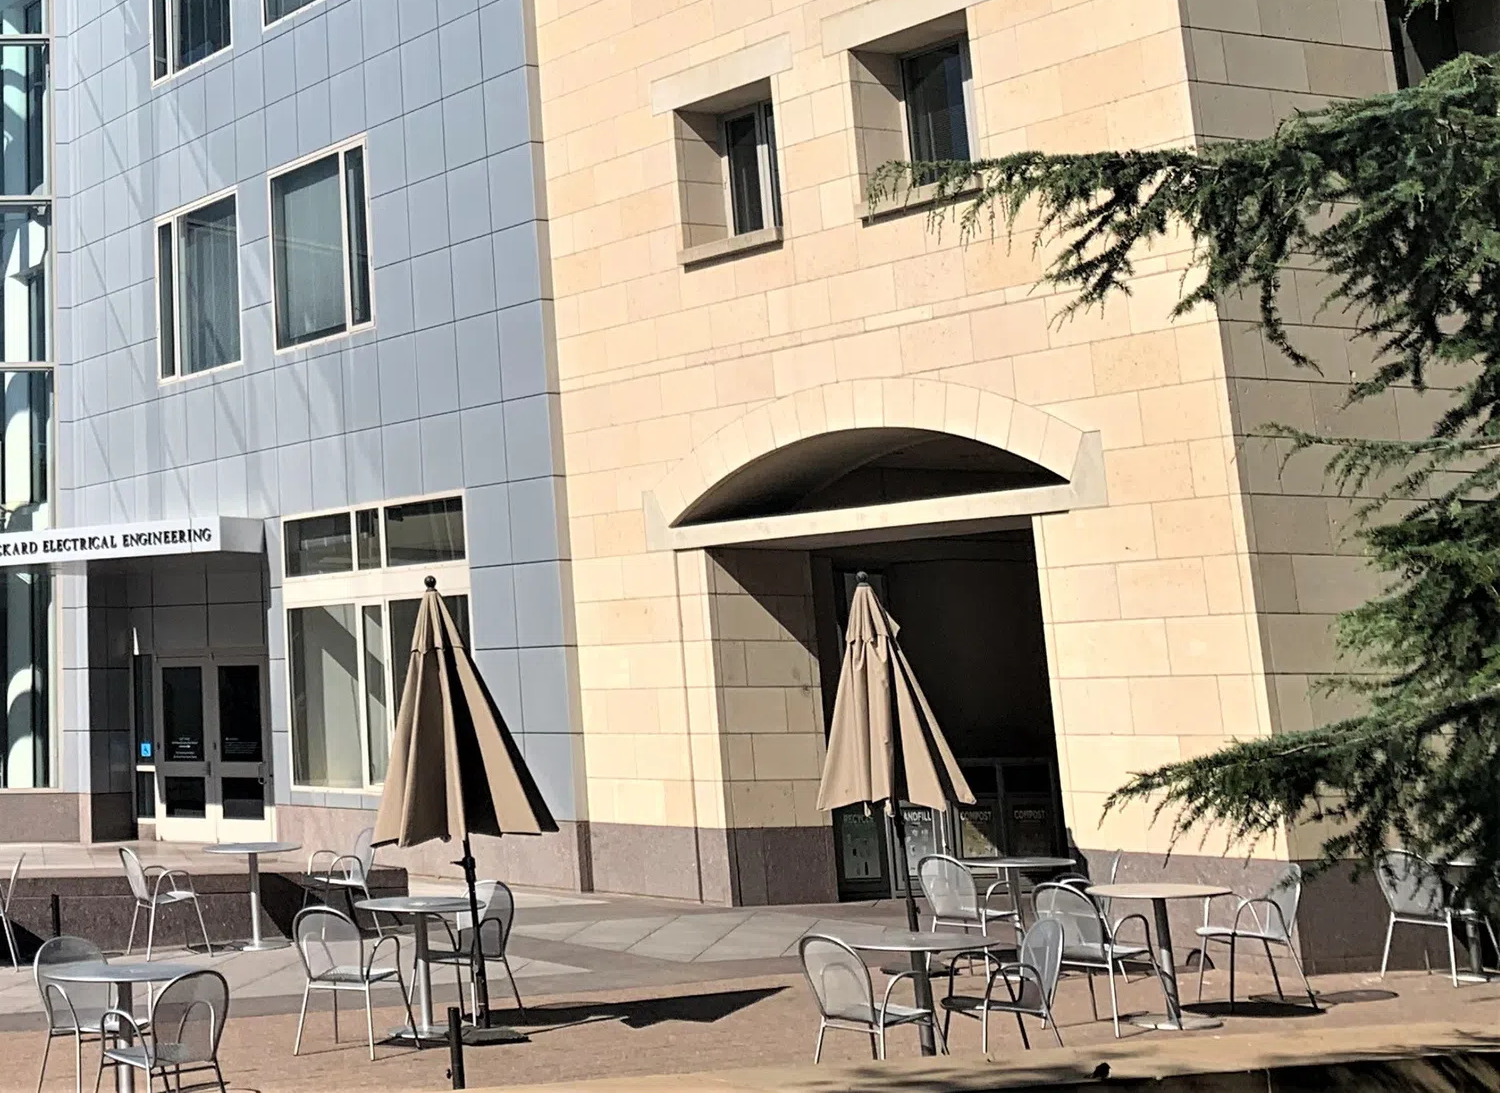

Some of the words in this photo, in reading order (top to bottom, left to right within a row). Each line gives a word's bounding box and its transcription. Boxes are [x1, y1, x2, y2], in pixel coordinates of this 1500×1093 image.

[42, 535, 118, 554] ELECTRICAL
[122, 527, 212, 548] ENGINEERING
[903, 811, 932, 822] ANDFILL
[959, 811, 991, 822] COMPOST
[1013, 809, 1046, 821] COMPOST
